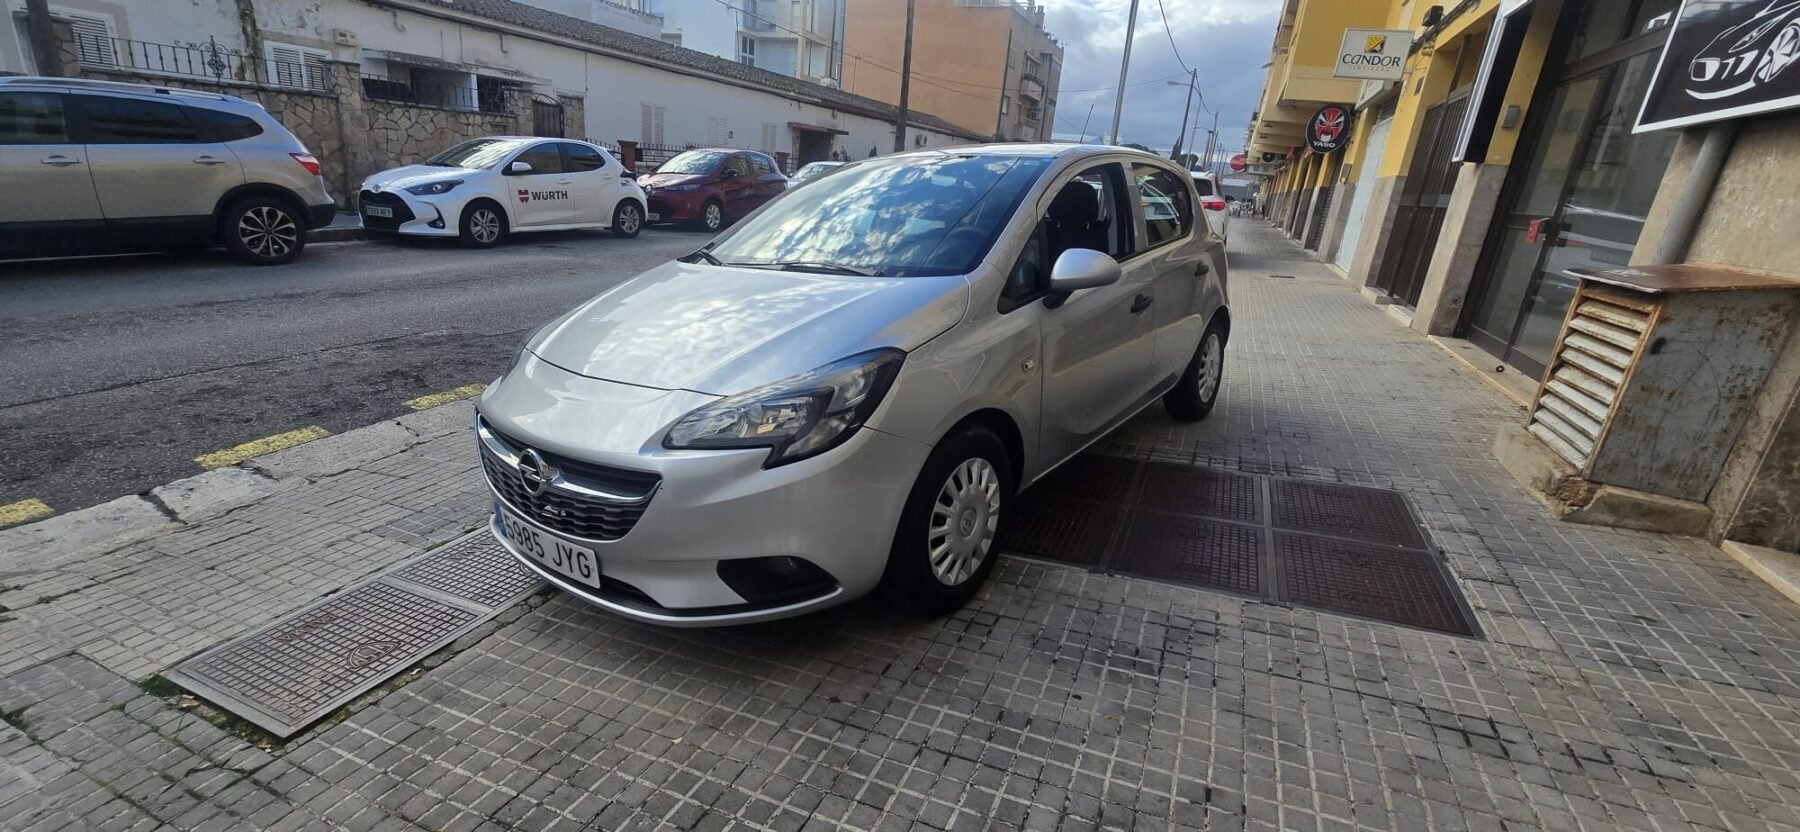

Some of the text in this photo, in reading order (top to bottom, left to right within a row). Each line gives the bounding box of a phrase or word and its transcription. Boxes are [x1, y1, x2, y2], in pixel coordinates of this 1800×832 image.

[1313, 140, 1336, 148] YASO
[531, 190, 568, 201] WÜRTH
[504, 516, 545, 559] 5985
[552, 542, 592, 579] JYG
